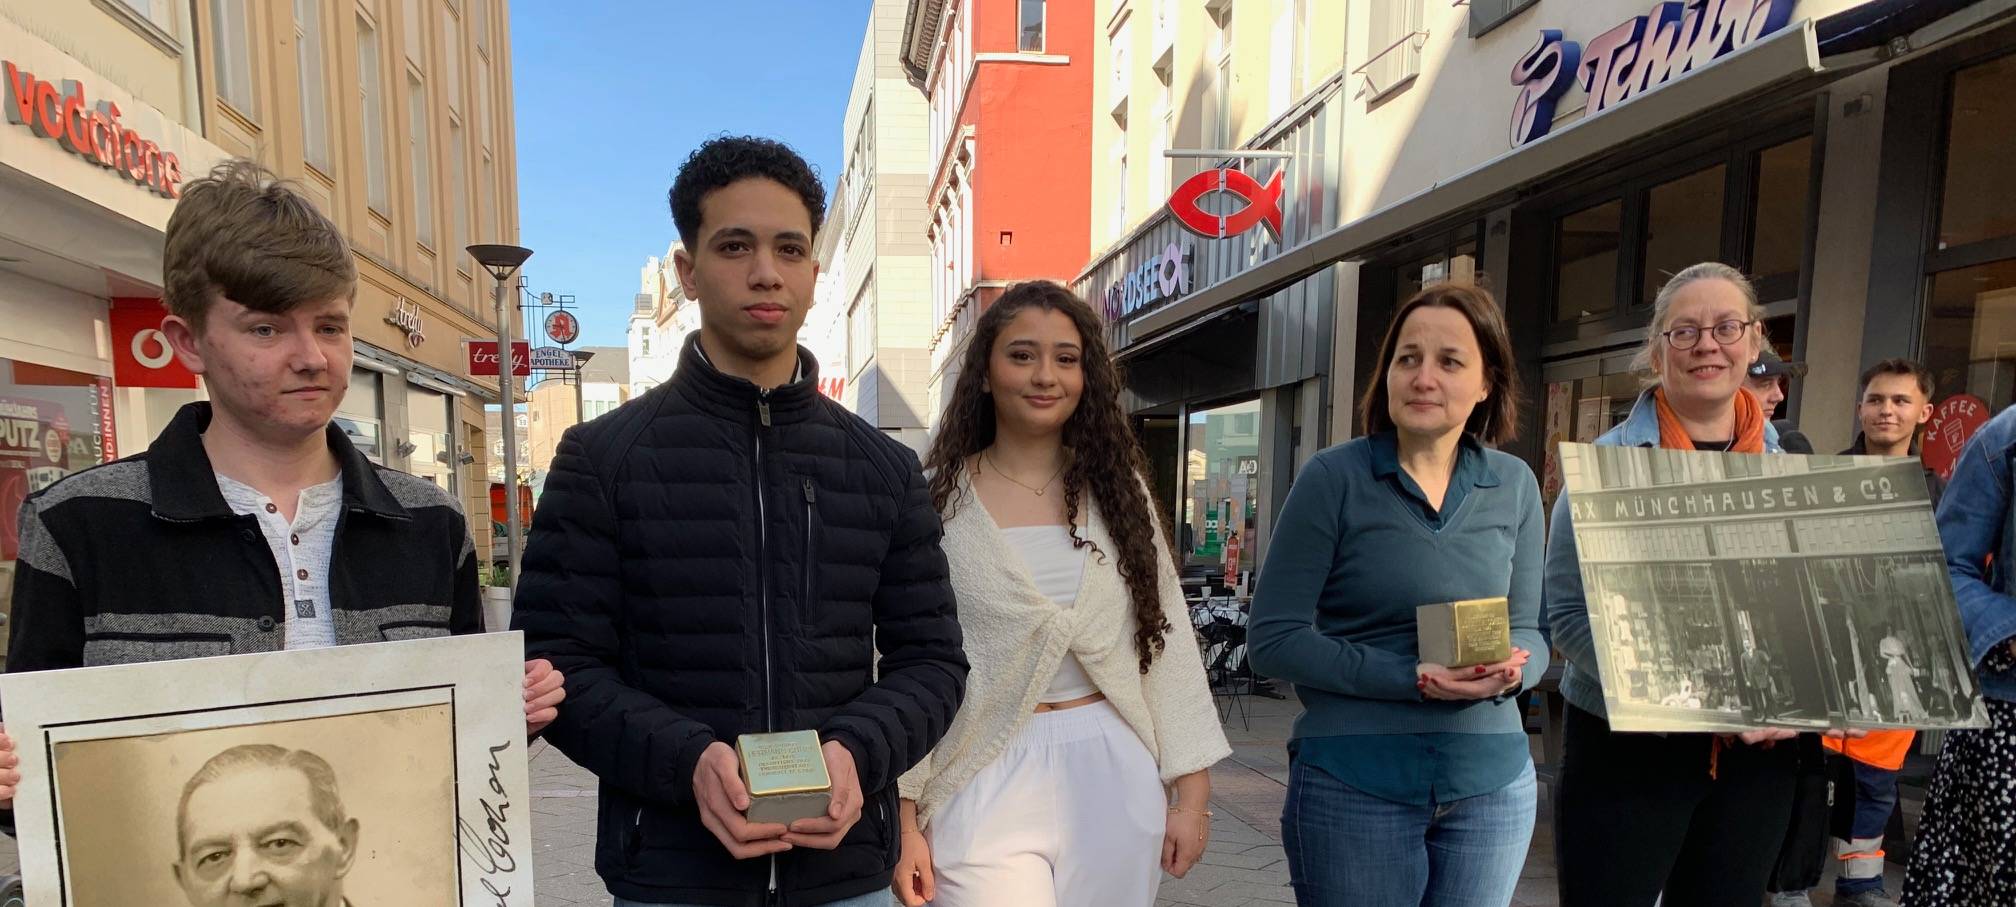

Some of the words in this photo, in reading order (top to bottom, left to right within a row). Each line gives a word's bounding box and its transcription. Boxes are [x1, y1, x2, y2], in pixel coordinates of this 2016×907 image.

[2, 60, 182, 199] vodafone
[1103, 255, 1162, 320] NORDSEE
[473, 348, 527, 371] trey
[531, 358, 570, 367] APOTHEKE
[536, 350, 562, 358] ENGEL
[1927, 400, 1977, 440] KAFFEE
[92, 423, 103, 466] AUCH
[1615, 485, 1820, 518] MÜNCHHAUSEN
[1833, 486, 1846, 503] &
